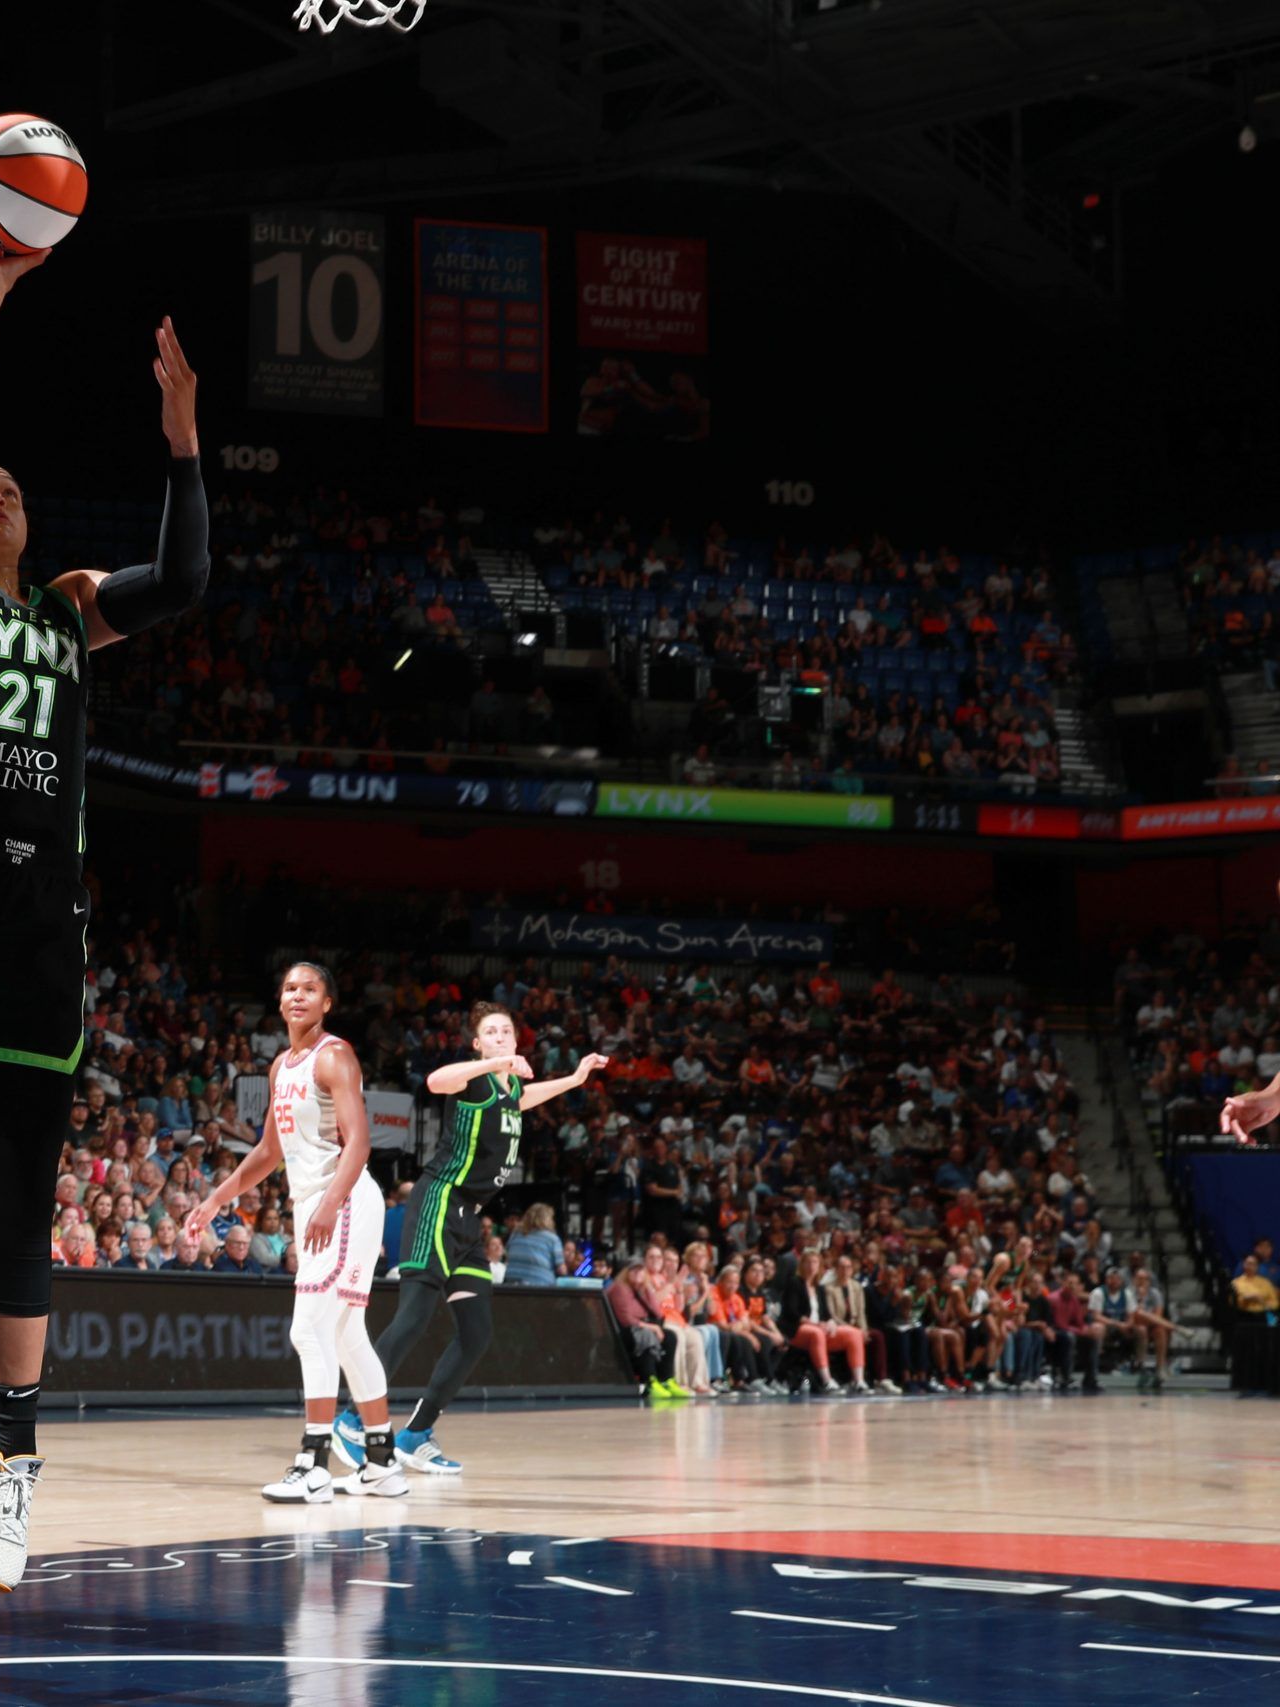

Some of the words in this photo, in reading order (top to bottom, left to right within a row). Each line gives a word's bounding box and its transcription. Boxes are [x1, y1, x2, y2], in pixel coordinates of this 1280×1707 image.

[253, 223, 315, 246] BILLY
[322, 228, 381, 252] JOEL
[432, 252, 499, 272] ARENA
[505, 257, 529, 273] OF
[603, 245, 680, 272] FIGHT
[435, 272, 473, 292] THE
[478, 275, 529, 294] YEAR
[610, 266, 633, 284] OF
[639, 270, 673, 287] THE
[252, 251, 383, 362] 10
[583, 283, 703, 315] CENTURY
[219, 444, 280, 474] 109
[764, 479, 816, 506] 110
[309, 774, 399, 802] SUN
[456, 780, 490, 807] 79
[608, 789, 713, 815] LYNX
[1137, 807, 1220, 831] ANTHEM
[1224, 806, 1268, 824] AND
[5, 838, 36, 854] CHANGE
[11, 855, 23, 865] US
[578, 860, 622, 890] 18
[518, 914, 650, 950] Mohegan
[655, 922, 721, 953] Sun
[724, 923, 824, 957] Arena
[275, 1104, 294, 1134] 25
[500, 1113, 522, 1136] LYN
[505, 1137, 520, 1166] 10
[771, 1562, 1280, 1616] NBA
